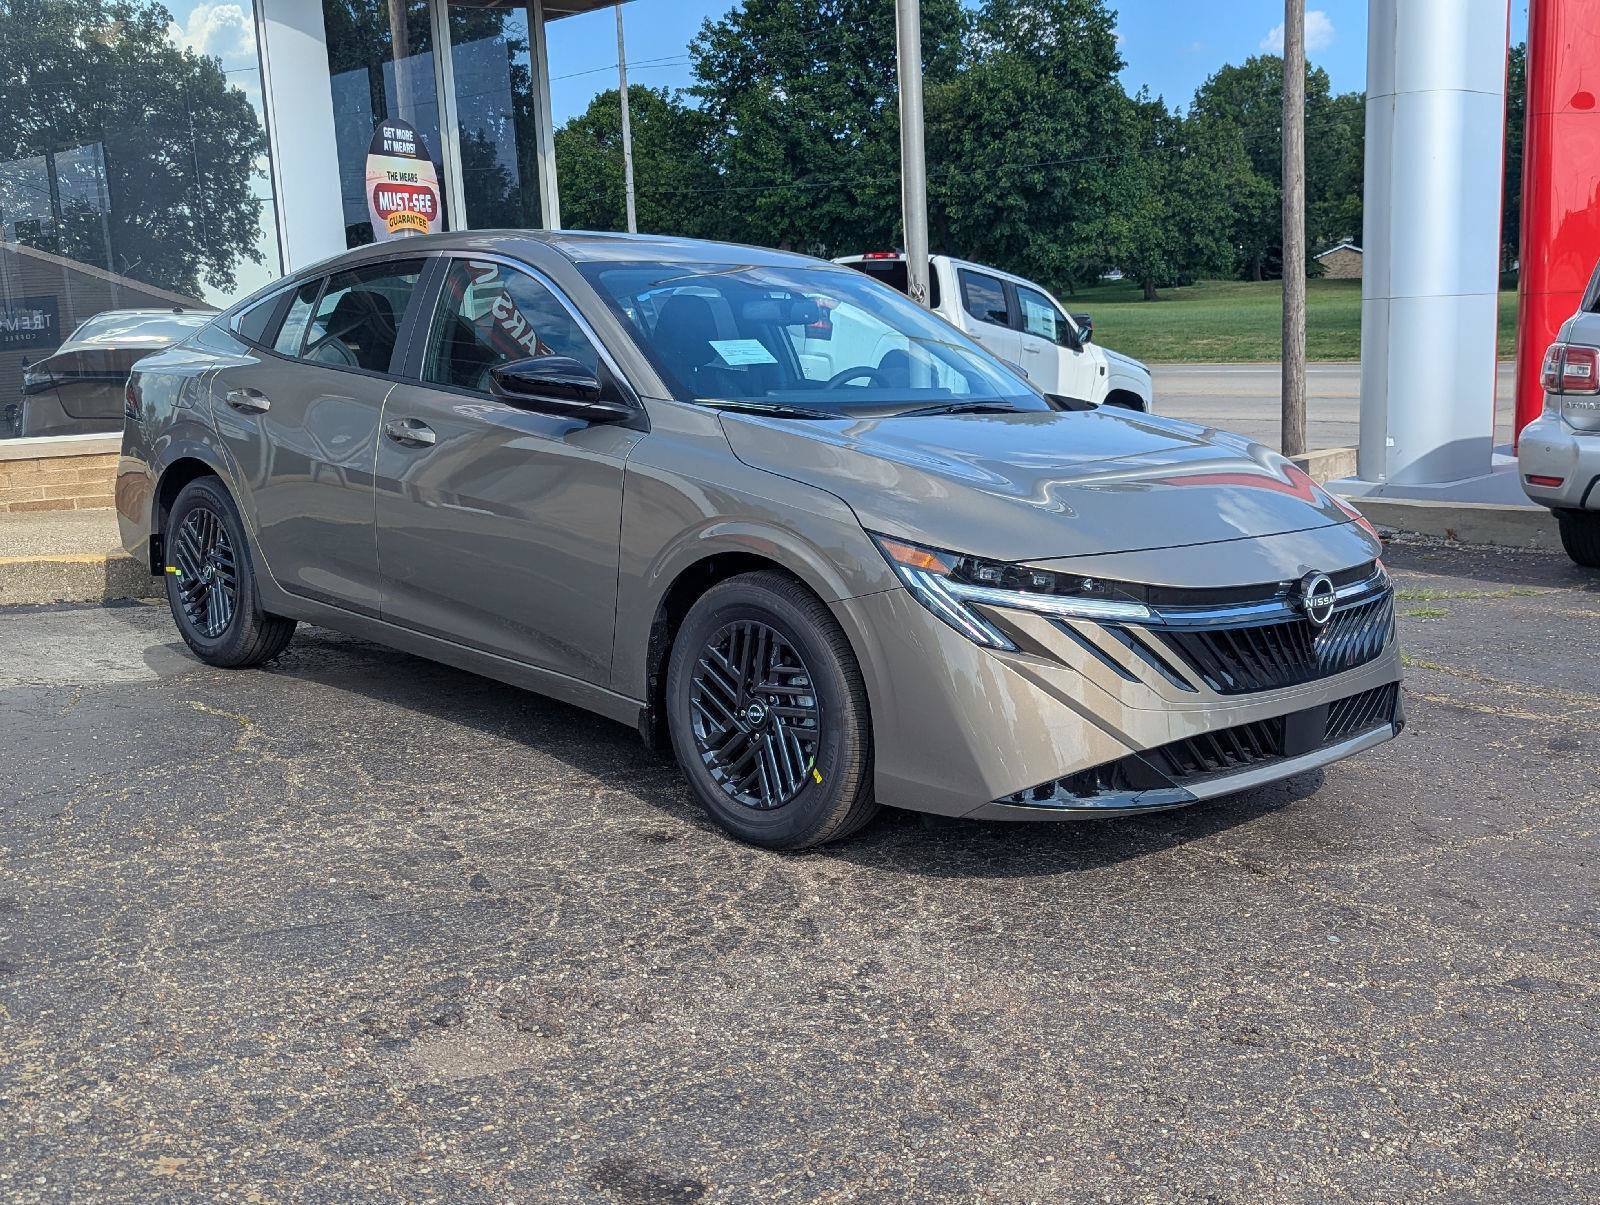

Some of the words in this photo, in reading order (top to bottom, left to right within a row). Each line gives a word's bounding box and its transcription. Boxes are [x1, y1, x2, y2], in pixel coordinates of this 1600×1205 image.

[383, 127, 394, 139] GET
[396, 128, 414, 141] MORE
[383, 140, 392, 151] AT
[393, 141, 416, 154] MEARS!
[387, 171, 398, 182] THE
[400, 172, 418, 183] MEARS
[379, 191, 432, 212] MUST-SEE
[389, 213, 427, 229] GUARANTEE
